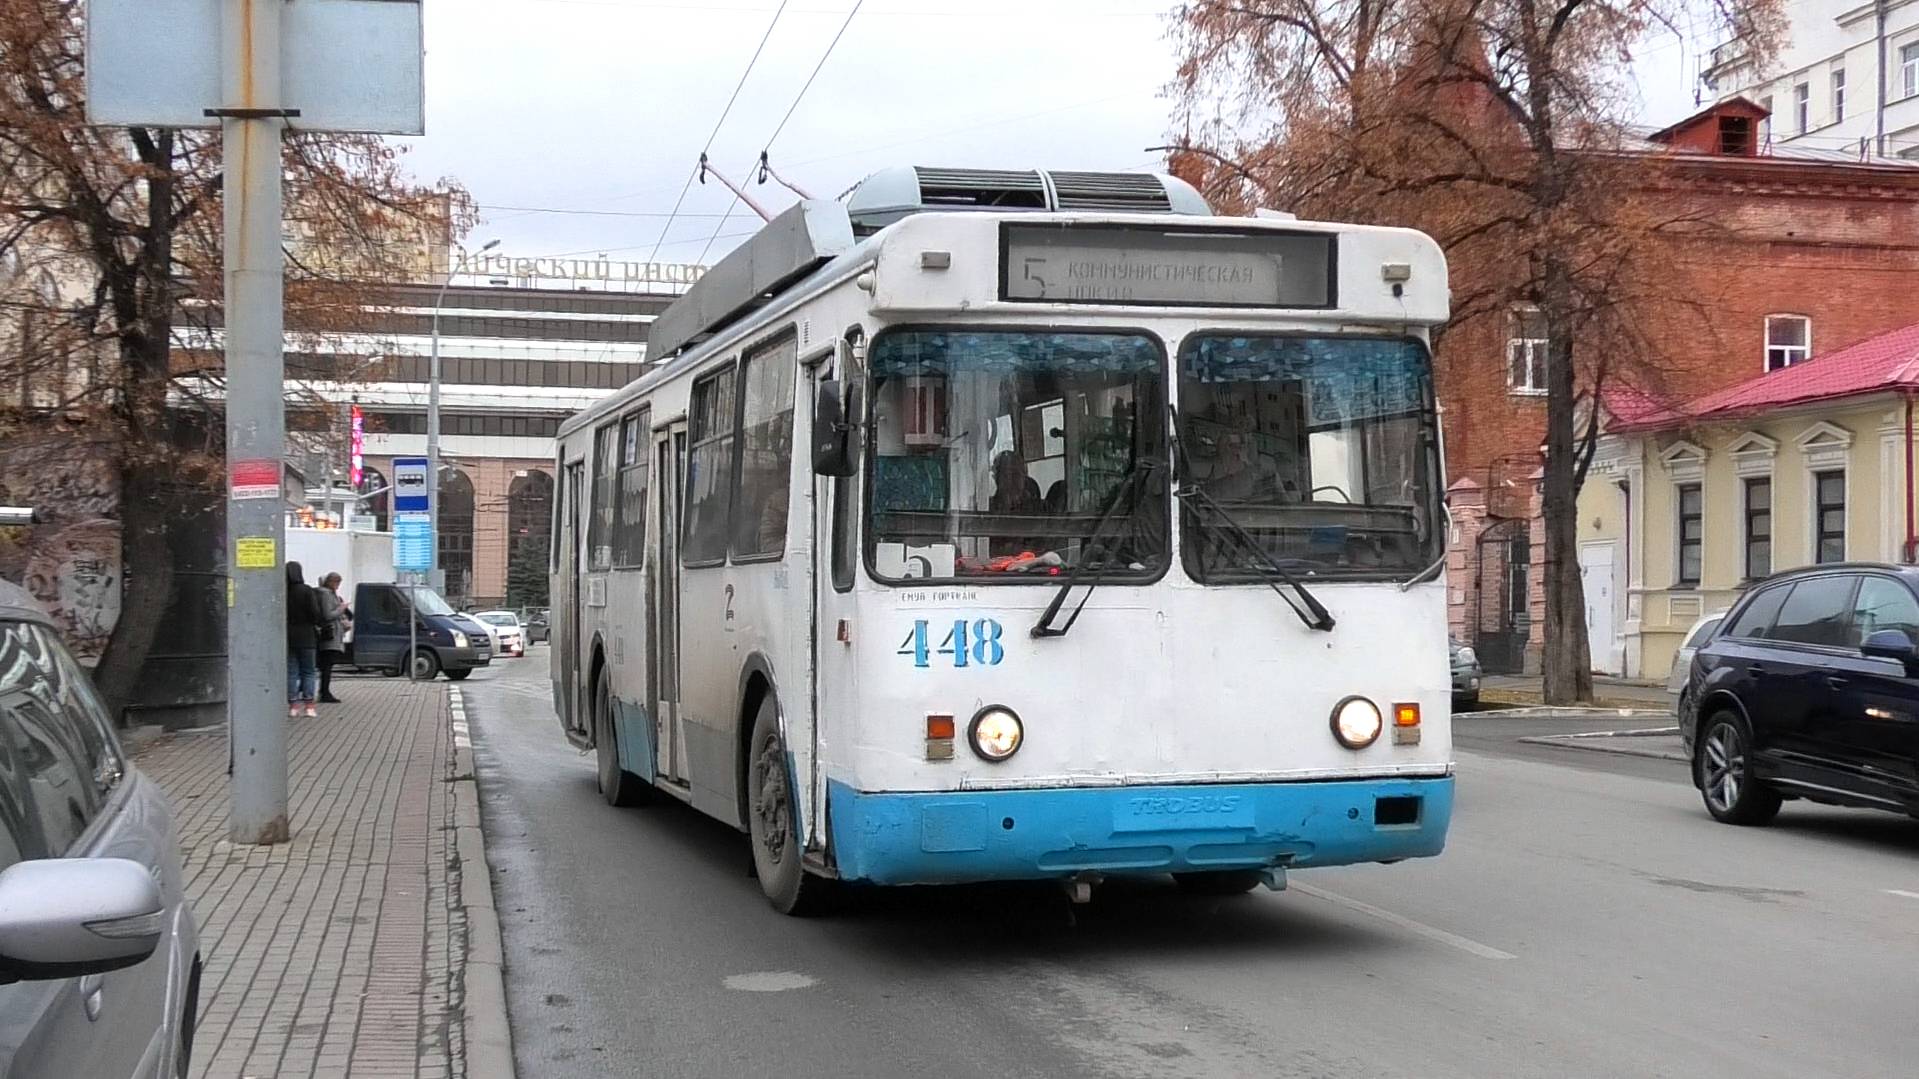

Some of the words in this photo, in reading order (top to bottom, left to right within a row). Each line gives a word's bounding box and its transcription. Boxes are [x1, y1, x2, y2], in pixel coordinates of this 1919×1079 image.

[1024, 257, 1047, 298] 5
[1068, 261, 1254, 283] КОММУНИСТИЧЕСКАЯ
[903, 542, 933, 578] 5
[725, 583, 735, 621] 2
[897, 618, 1004, 668] 448
[1130, 795, 1241, 816] TROBUS
